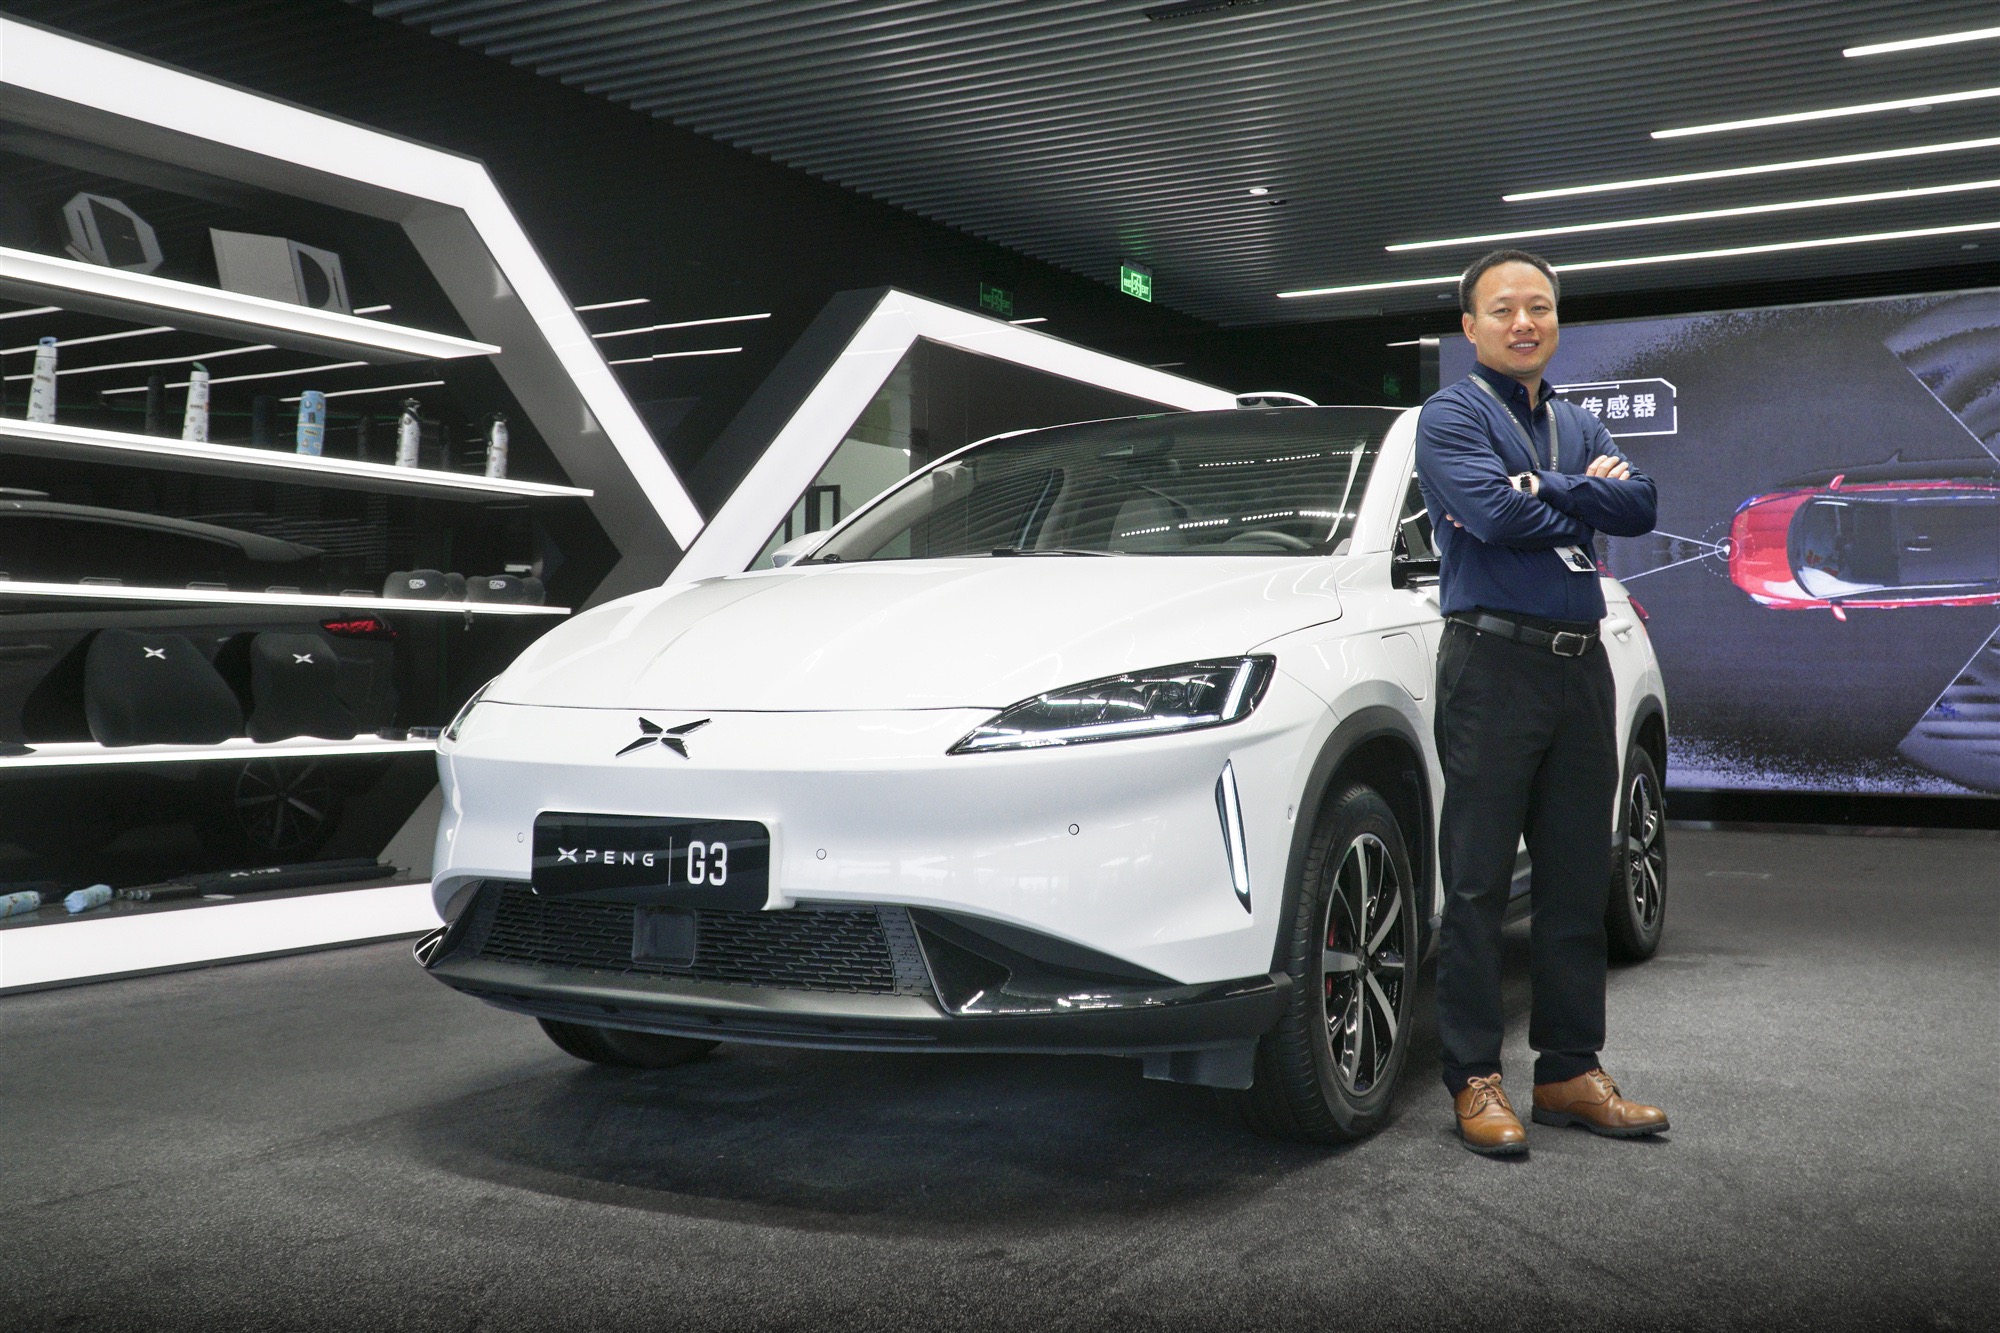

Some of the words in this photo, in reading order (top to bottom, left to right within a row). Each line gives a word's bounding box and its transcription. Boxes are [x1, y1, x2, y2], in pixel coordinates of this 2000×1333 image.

[1563, 393, 1657, 419] 传感器
[557, 847, 654, 867] XPENG
[687, 841, 727, 886] G3
